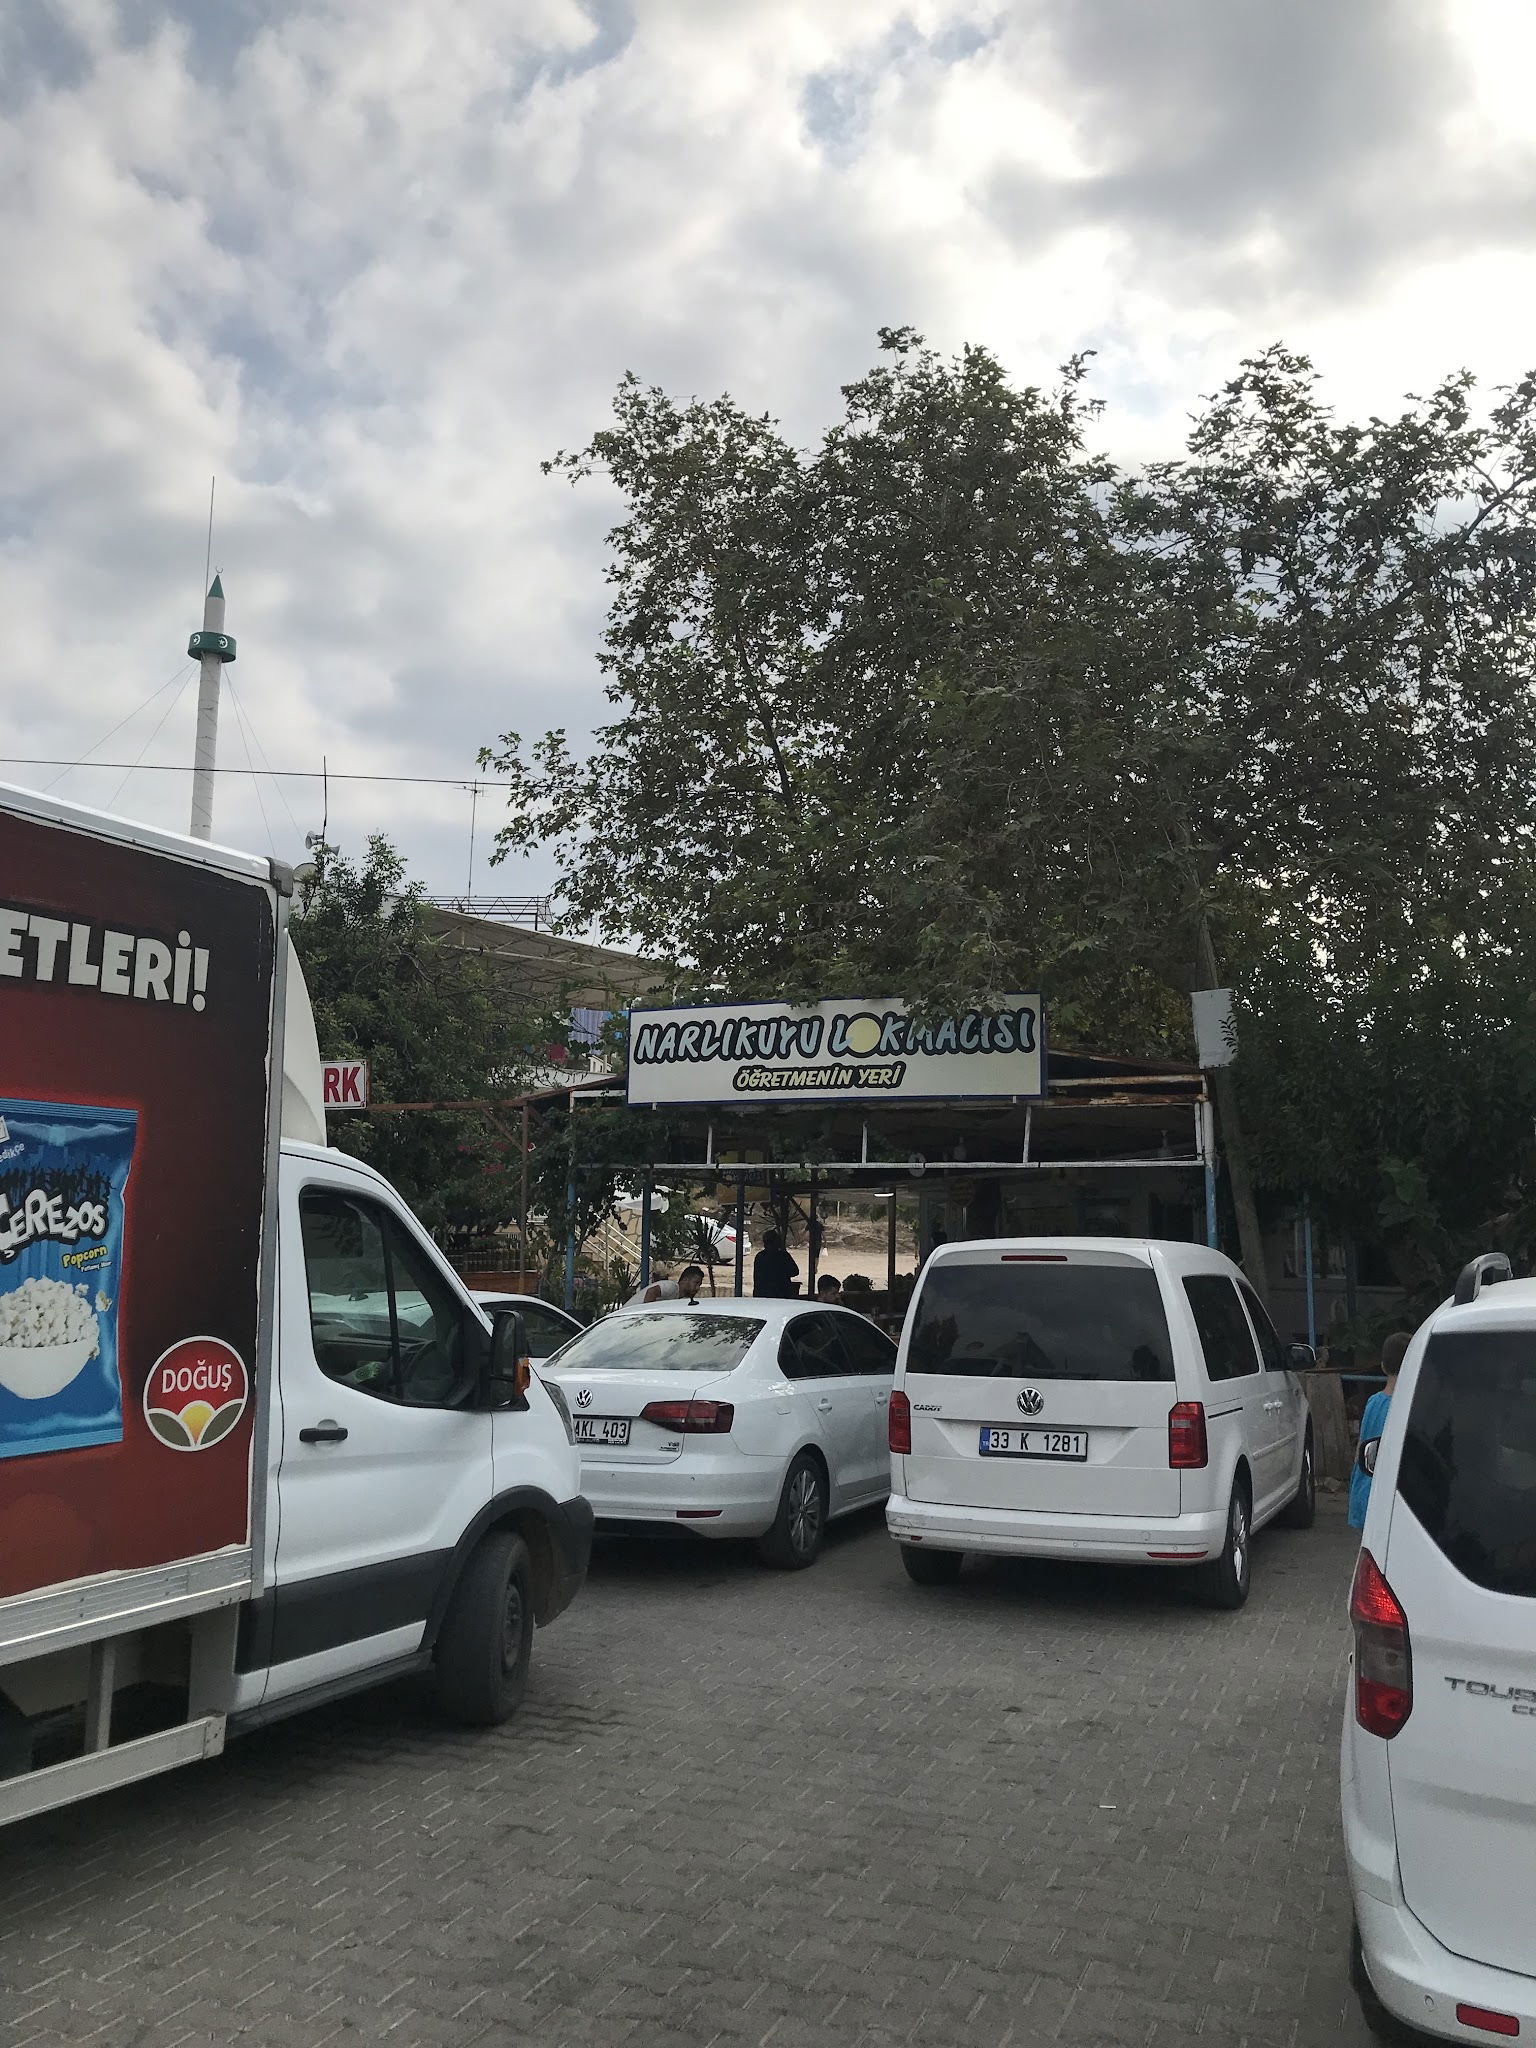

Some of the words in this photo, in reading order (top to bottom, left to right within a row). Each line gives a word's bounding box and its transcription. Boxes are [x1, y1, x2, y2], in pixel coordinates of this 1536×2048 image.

[635, 1017, 822, 1063] NARLIKUYU
[830, 1010, 1033, 1055] LOKMACISI
[323, 1066, 361, 1103] RK
[735, 1066, 853, 1089] ÖĞRETMENİN
[858, 1064, 902, 1086] YERİ
[62, 1245, 108, 1268] Popcorn
[161, 1359, 233, 1394] DOĞUŞ
[602, 1422, 627, 1439] 403
[990, 1431, 1010, 1449] 33
[1020, 1432, 1029, 1451] K
[1043, 1433, 1080, 1453] 1281
